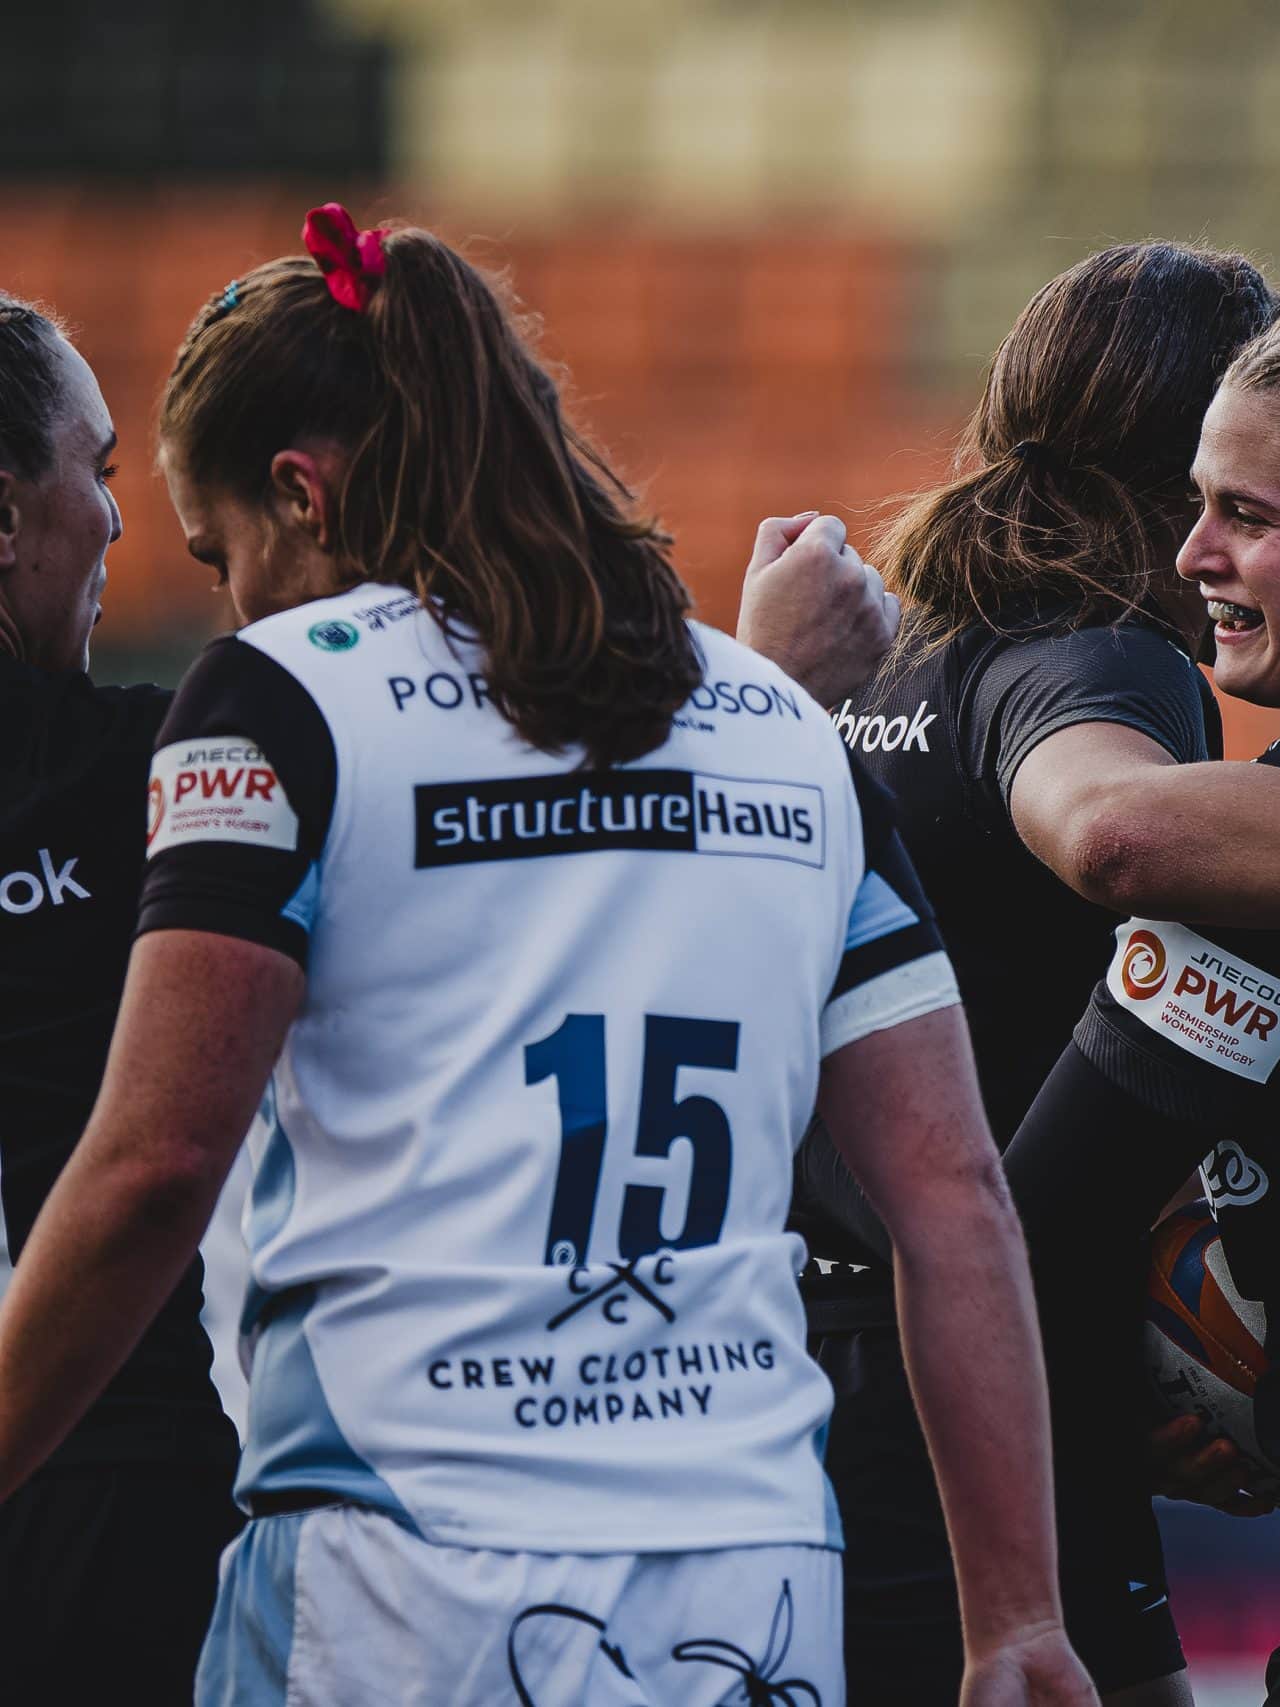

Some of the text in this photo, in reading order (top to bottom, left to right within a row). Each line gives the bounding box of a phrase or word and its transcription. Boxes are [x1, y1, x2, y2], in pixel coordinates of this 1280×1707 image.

[388, 672, 801, 720] POR DSON
[832, 699, 938, 752] brook
[179, 747, 266, 767] JAECO
[173, 768, 276, 804] PWR
[432, 787, 814, 845] structureHaus
[1165, 1001, 1240, 1046] PREMIERSHIP
[1173, 965, 1279, 1042] PWR
[1161, 1012, 1256, 1066] WOMEN'S RUGBY
[524, 1014, 741, 1266] 15
[428, 1340, 776, 1390] CREW CLOTHING
[515, 1384, 713, 1428] COMPANY
